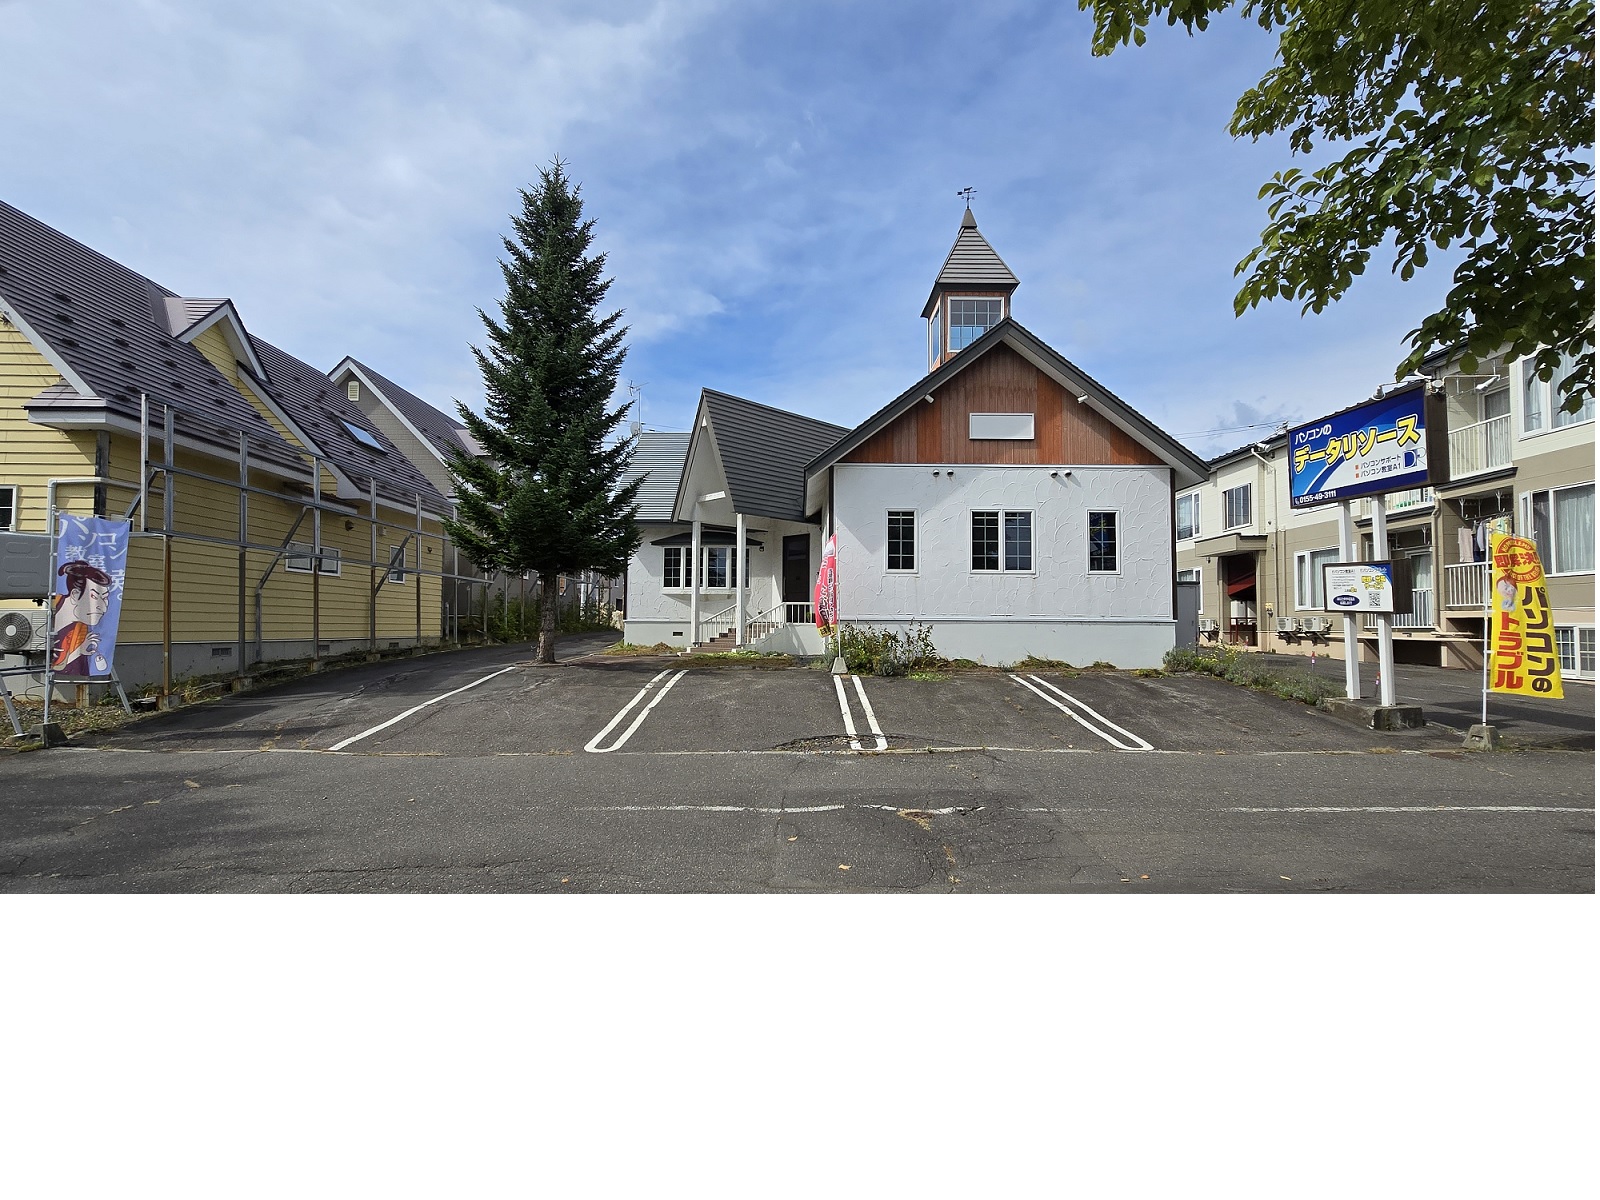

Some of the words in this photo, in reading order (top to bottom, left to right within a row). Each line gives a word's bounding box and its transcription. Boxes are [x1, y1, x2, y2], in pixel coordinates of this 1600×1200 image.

[1294, 414, 1421, 474] データリソース
[1295, 424, 1332, 445] パソコンの
[1361, 454, 1401, 469] パソコンサポート
[1361, 463, 1401, 477] パソコン教室A1
[1299, 490, 1336, 503] 0155-49-3111
[59, 516, 127, 560] パソコン
[1495, 611, 1524, 689] トラブル
[1522, 586, 1555, 693] パソコンの
